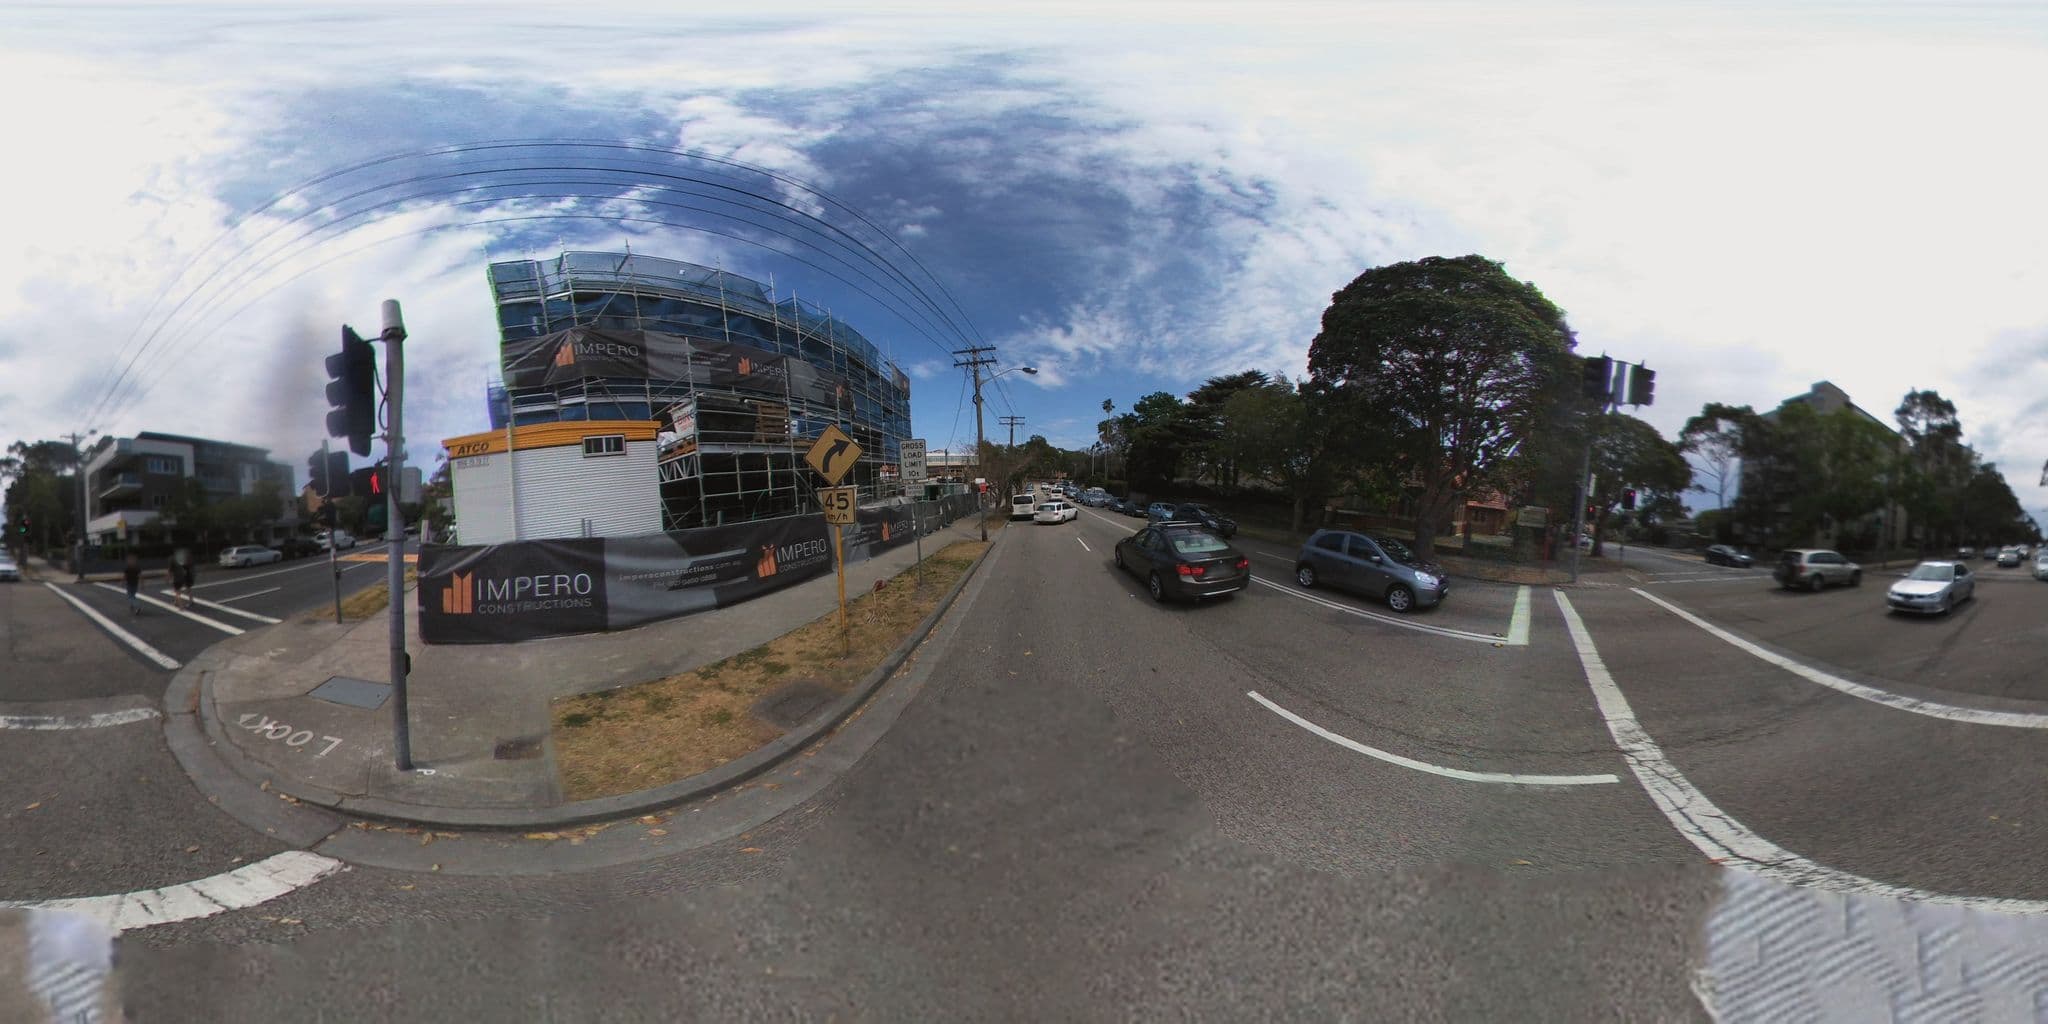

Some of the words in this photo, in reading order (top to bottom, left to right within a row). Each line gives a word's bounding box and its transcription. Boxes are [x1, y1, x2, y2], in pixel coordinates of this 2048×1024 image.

[575, 342, 639, 357] IMPERO
[457, 442, 490, 456] ATCO
[901, 442, 924, 450] GROSS
[903, 451, 922, 460] LOAD
[904, 460, 922, 469] LIMIT
[825, 492, 849, 511] 45
[827, 513, 848, 521] km/h
[776, 538, 827, 563] IMPERO
[477, 573, 592, 601] IMPERO
[478, 597, 592, 615] CONSTRUCTIONS
[253, 715, 343, 758] LOOK
